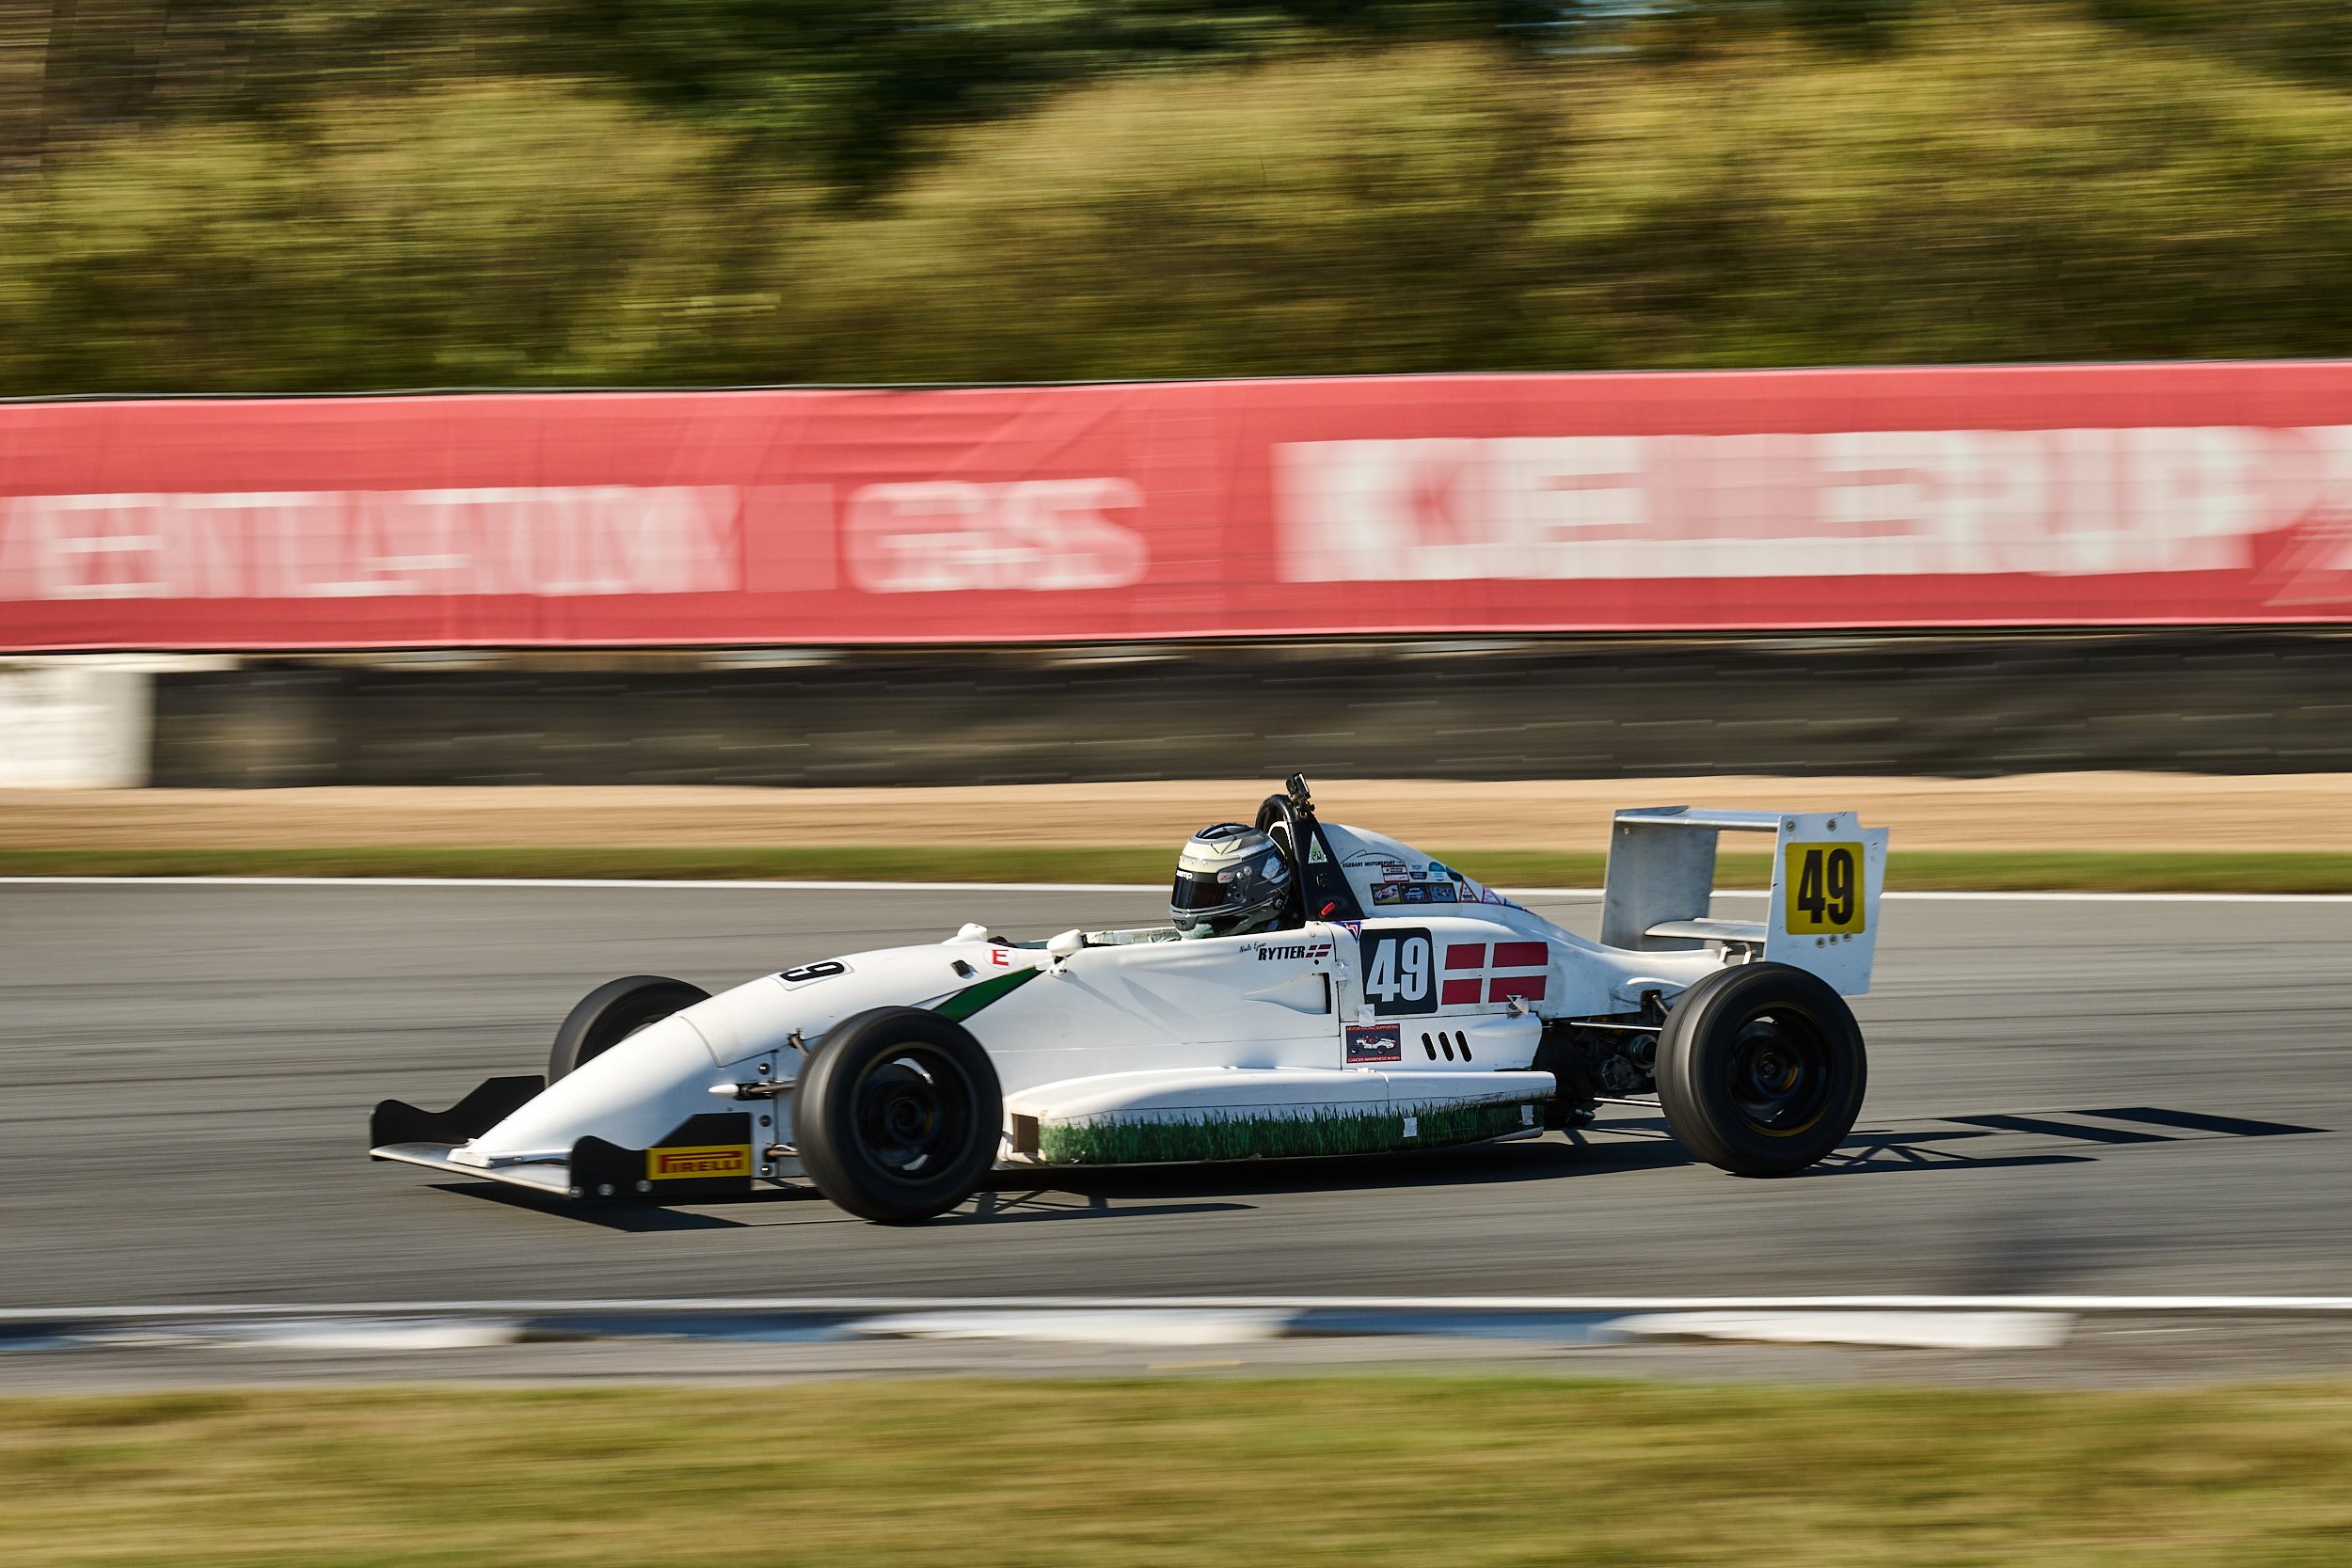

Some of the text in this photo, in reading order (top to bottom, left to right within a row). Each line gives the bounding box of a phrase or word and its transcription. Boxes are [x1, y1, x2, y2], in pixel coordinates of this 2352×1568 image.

[1797, 847, 1855, 926] 49
[993, 949, 1009, 966] E
[1258, 945, 1306, 961] RYTTER
[1366, 937, 1430, 1003] 49
[658, 1150, 744, 1174] PIRELLI
